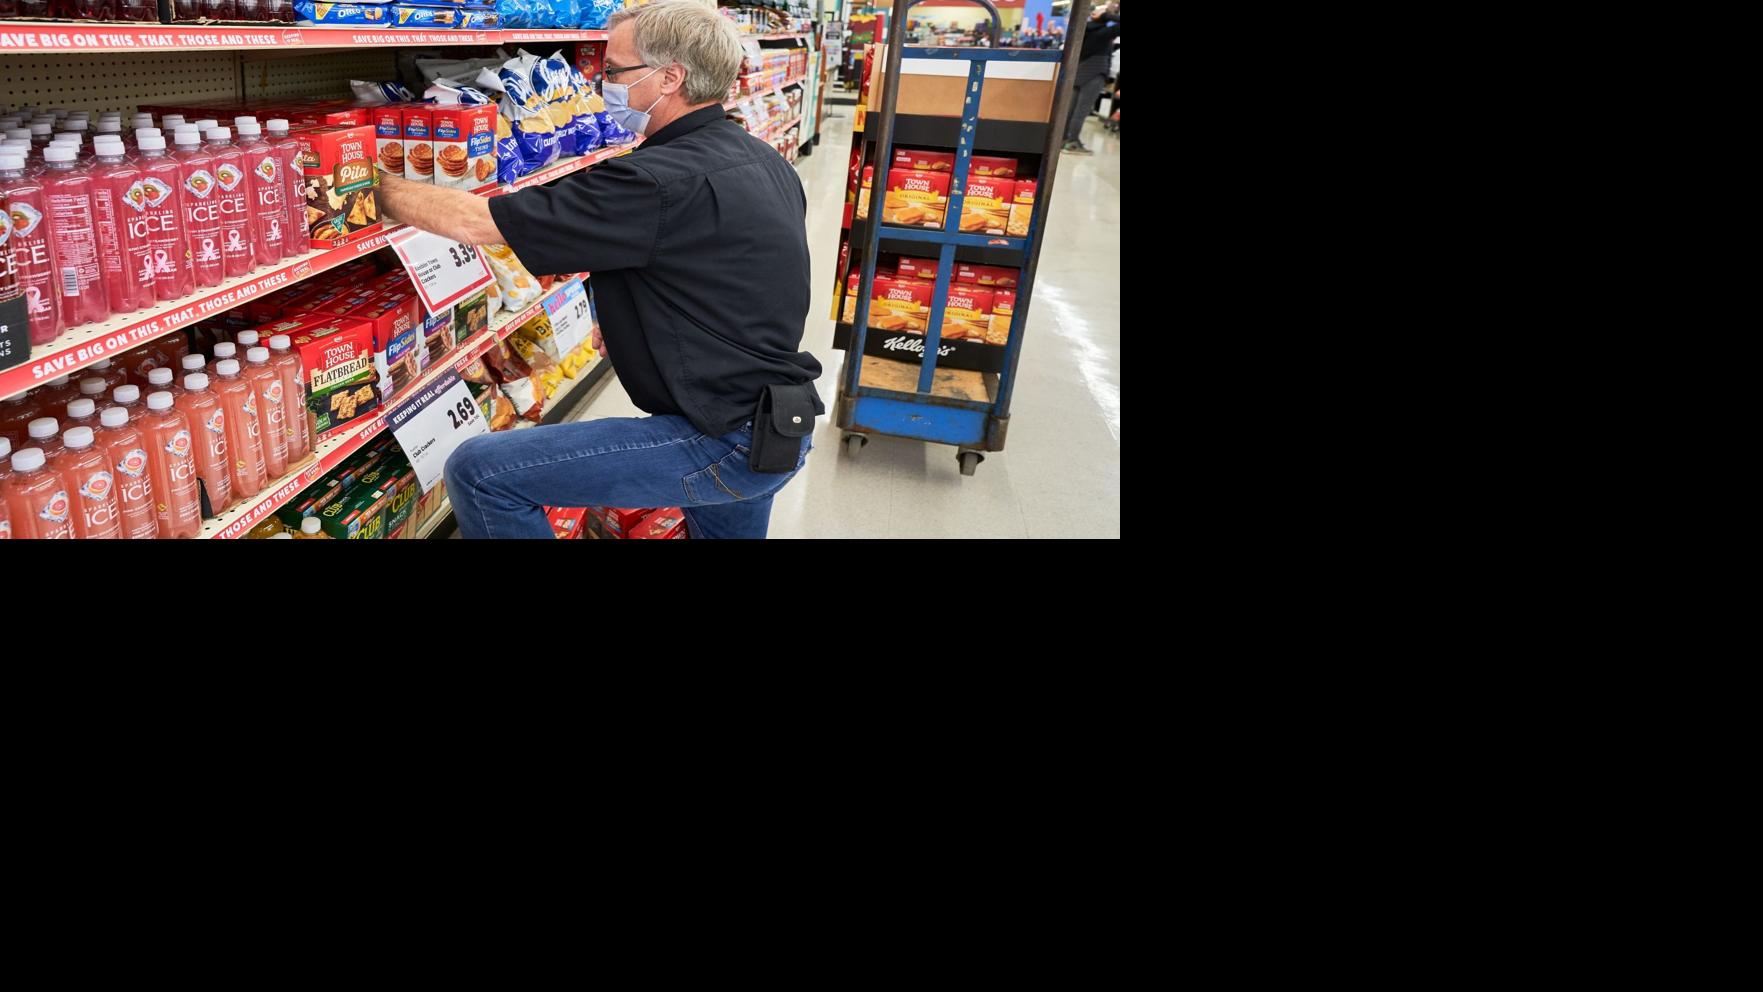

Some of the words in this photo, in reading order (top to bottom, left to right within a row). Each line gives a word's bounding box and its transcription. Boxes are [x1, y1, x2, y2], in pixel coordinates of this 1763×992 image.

[0, 33, 38, 47] AVE
[39, 33, 71, 47] BIG
[73, 34, 99, 47] ON
[178, 34, 221, 46] THOSE
[221, 34, 243, 45] AND
[245, 34, 277, 45] THESE
[352, 35, 371, 44] SAVE
[371, 35, 384, 43] BIG
[384, 35, 394, 43] ON
[429, 35, 446, 43] THOSE
[474, 117, 488, 126] TOWN
[341, 141, 362, 154] TOWN
[341, 151, 365, 164] HOUSE
[340, 165, 369, 183] Pita
[905, 177, 930, 186] TOWN
[904, 184, 930, 192] HOUSE
[967, 190, 994, 198] HOUSE
[968, 184, 994, 193] TOWN
[186, 204, 220, 222] ICE
[356, 238, 375, 252] SAVE
[449, 243, 477, 268] 3.39
[887, 294, 913, 302] HOUSE
[889, 287, 913, 297] TOWN
[949, 295, 973, 304] TOWN
[947, 301, 973, 309] HOUSE
[32, 353, 76, 378] SAVE
[77, 342, 104, 361] BIG
[106, 333, 128, 350] ON
[198, 292, 236, 313] THOSE
[237, 284, 257, 300] AND
[258, 272, 288, 290] THESE
[393, 312, 409, 328] TOWN
[324, 342, 353, 359] TOWN
[388, 334, 416, 357] FlipSides
[325, 350, 355, 368] HOUSE
[313, 357, 367, 387] FLATBREAD
[392, 403, 416, 425] KEEPING
[415, 399, 423, 408] IT
[421, 390, 435, 403] REAL
[447, 396, 476, 430] 2.69
[359, 422, 378, 440] SAVE
[170, 458, 196, 482] ICE
[121, 478, 152, 503] ICE
[392, 482, 416, 513] CLUB
[85, 500, 119, 528] ICE
[219, 514, 253, 539] THOSE
[253, 500, 273, 518] AND
[272, 478, 300, 503] THESE
